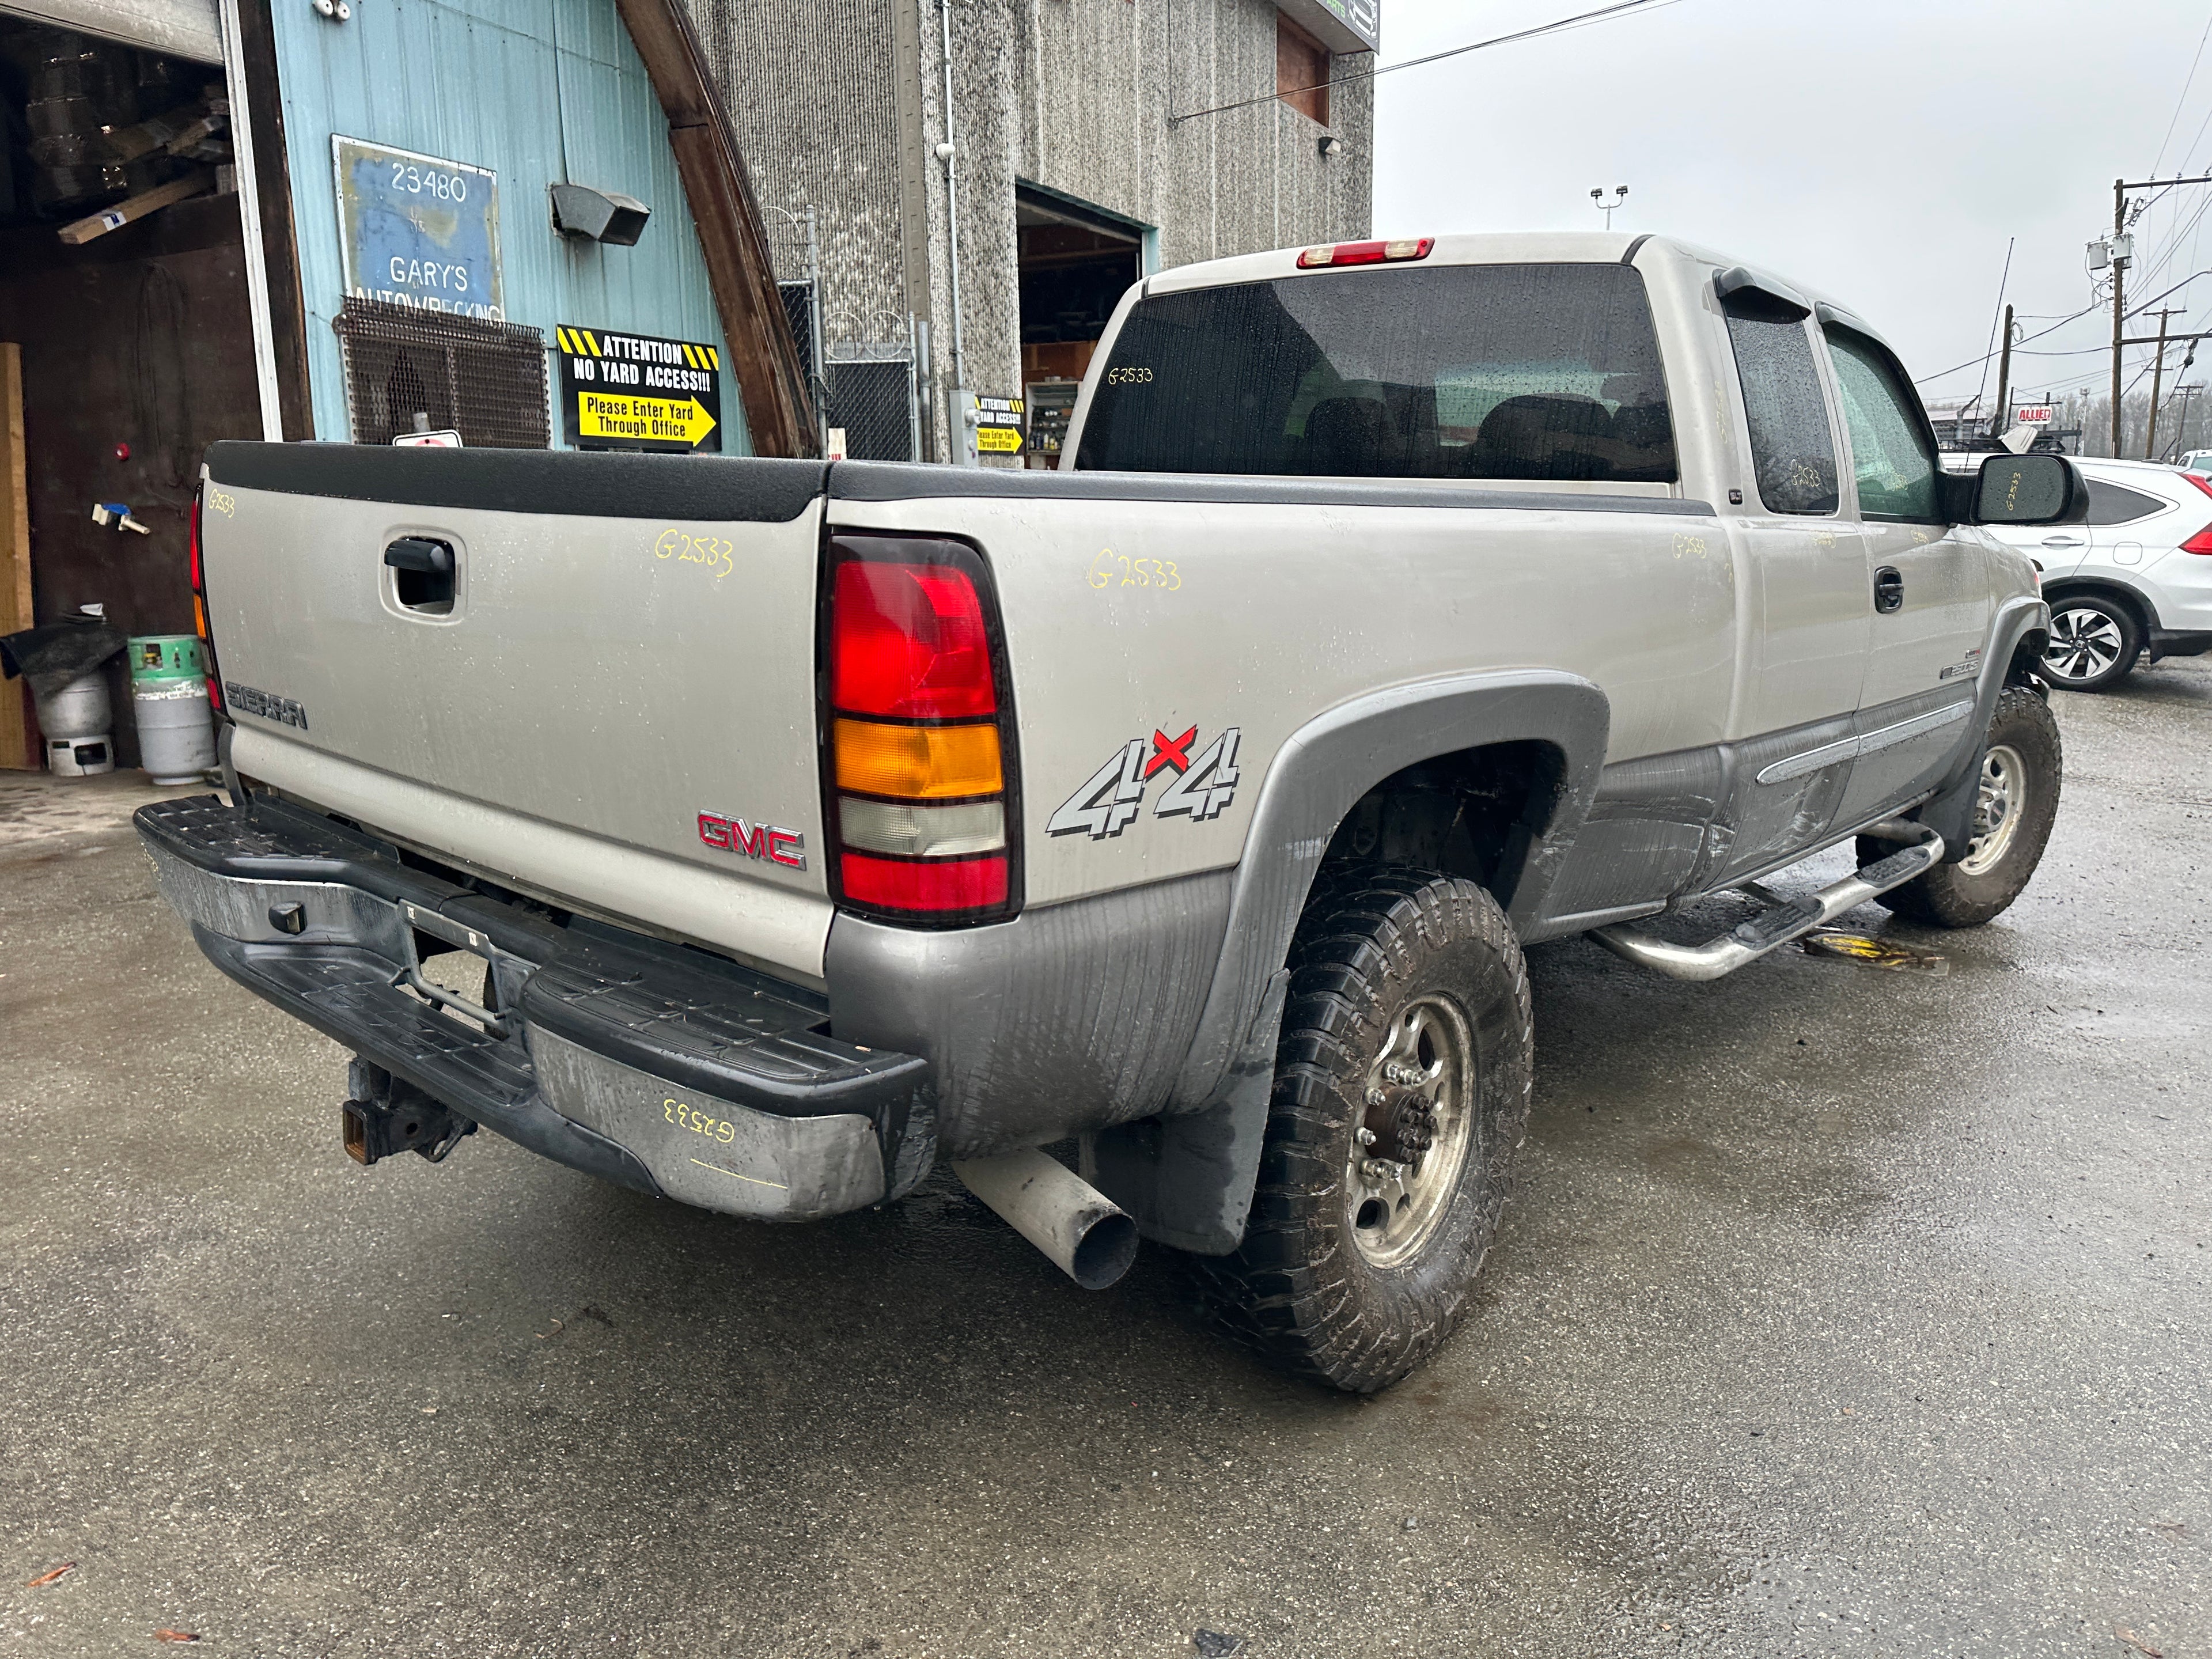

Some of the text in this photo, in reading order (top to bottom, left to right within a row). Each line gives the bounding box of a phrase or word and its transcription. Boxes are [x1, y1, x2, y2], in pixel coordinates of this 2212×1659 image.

[392, 162, 467, 202] 23480
[389, 256, 468, 291] GARY'S
[603, 335, 683, 365] ATTENTION
[573, 358, 710, 392] NO YARD ACCESS!!!
[1108, 368, 1153, 385] G2533
[587, 396, 693, 421] Please Enter Yard
[980, 397, 1010, 411] ATTENTION
[980, 411, 1021, 425] YARD ACCESS!!!
[597, 415, 686, 437] Through Office
[991, 430, 1003, 440] Enter
[1004, 431, 1014, 440] Yard
[979, 439, 1012, 449] Through Office
[655, 528, 733, 578] G2533
[1672, 532, 1707, 559] G2533
[1089, 548, 1181, 591] G2533
[225, 681, 308, 730] SIERRA
[697, 809, 807, 872] GMC
[664, 1099, 735, 1143] G2533
